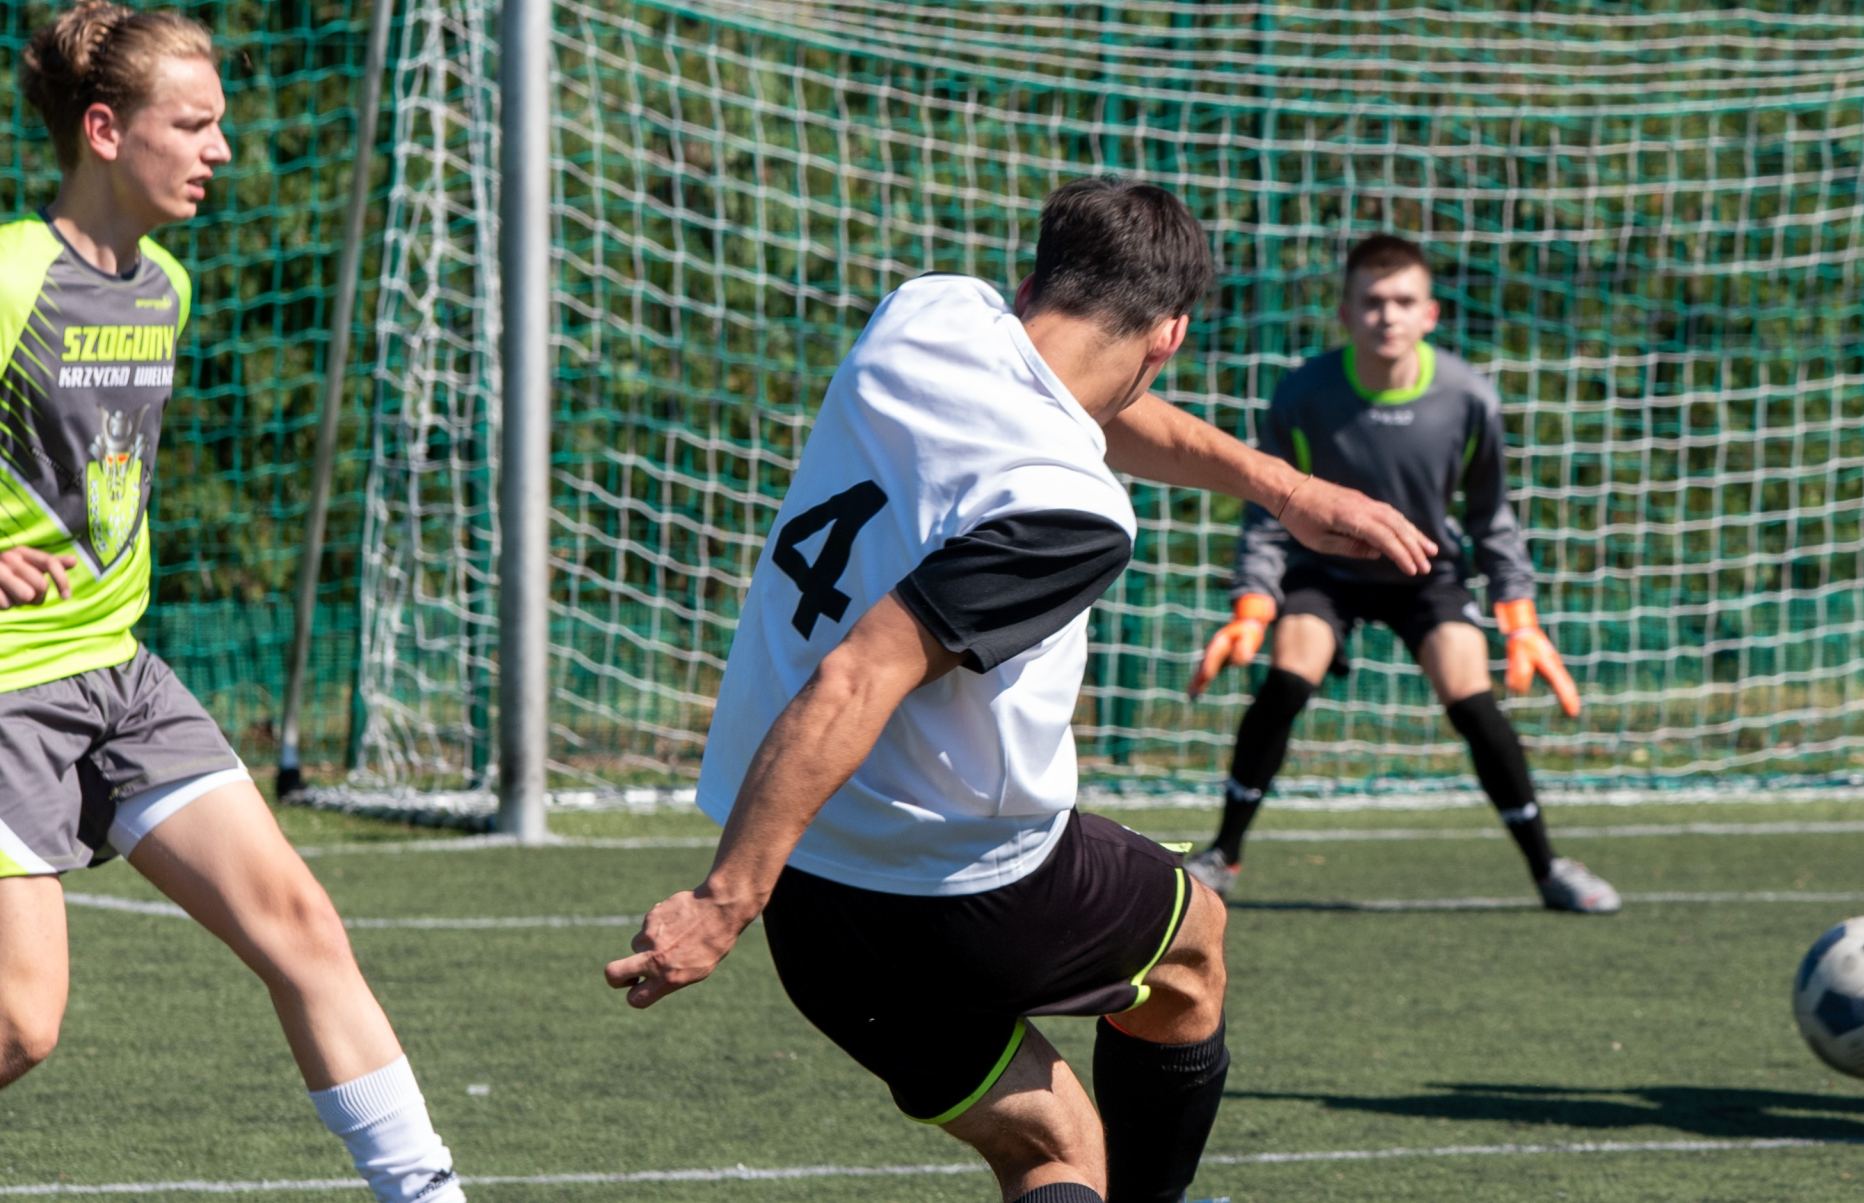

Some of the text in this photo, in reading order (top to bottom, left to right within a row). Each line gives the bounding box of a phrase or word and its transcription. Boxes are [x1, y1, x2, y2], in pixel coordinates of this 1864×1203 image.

[61, 325, 174, 362] SZOGUNY
[58, 366, 130, 388] KRZYCKO
[772, 480, 888, 641] 4
